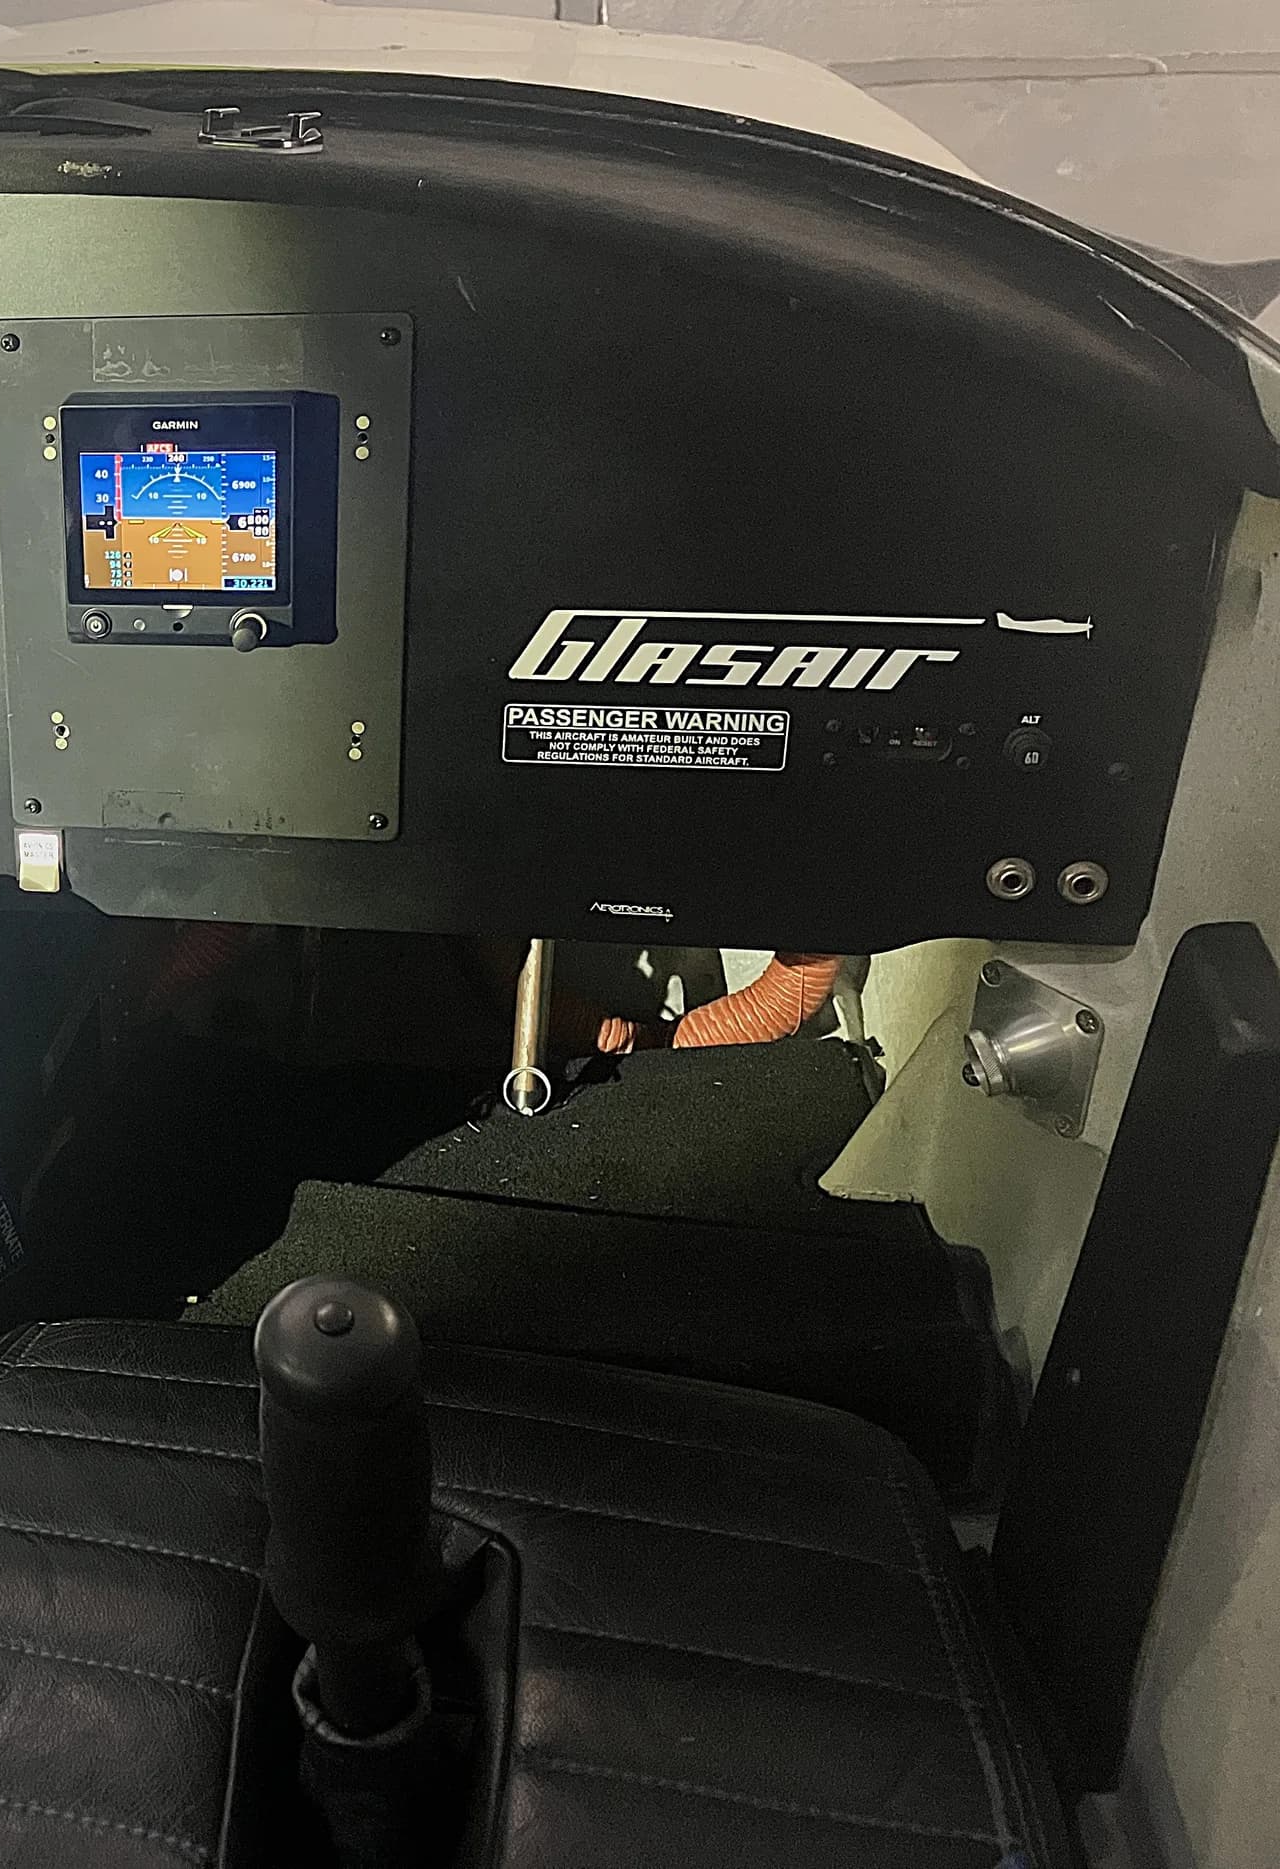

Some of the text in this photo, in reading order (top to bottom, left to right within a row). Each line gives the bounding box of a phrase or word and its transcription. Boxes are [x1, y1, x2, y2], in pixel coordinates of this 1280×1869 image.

[152, 420, 199, 430] GARMIN
[94, 470, 109, 479] 40
[231, 480, 257, 489] 6900
[96, 494, 109, 503] 30
[196, 492, 207, 500] 10
[231, 553, 257, 562] 6700
[508, 707, 785, 732] PASSENGER WARNING
[1020, 715, 1042, 724] ALT
[529, 731, 761, 746] THIS AIRCRAFT IS AMATEUR BUILT AND DOES
[549, 741, 739, 756] NOT COMPLY WITH FEDERAL SAFETY
[537, 751, 750, 767] REGULATIONS FOR STANDARD AIRCRAFT.
[590, 902, 664, 914] AEROTRONICS
